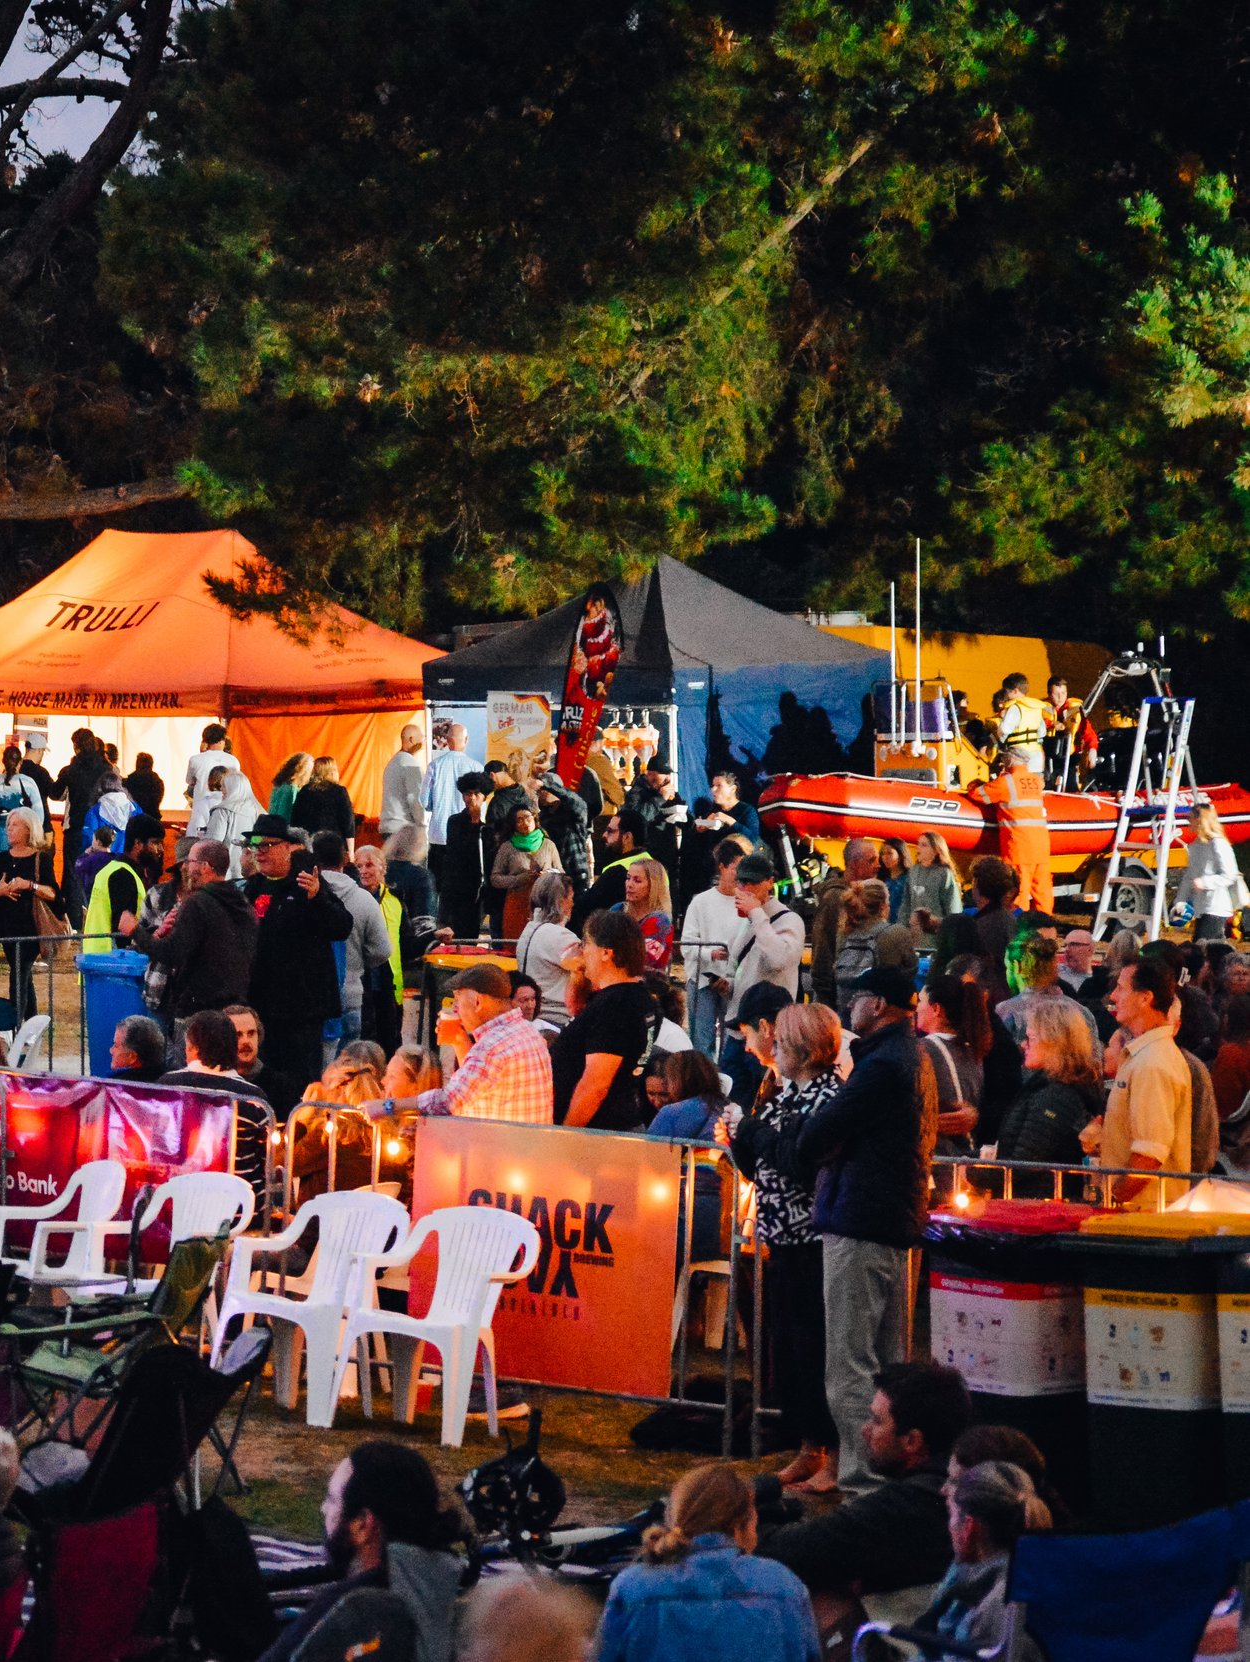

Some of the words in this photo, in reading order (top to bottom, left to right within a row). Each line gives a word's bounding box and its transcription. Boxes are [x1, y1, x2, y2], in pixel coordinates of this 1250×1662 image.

[46, 601, 160, 632] TRULLI
[8, 690, 90, 710] HOUSE-MADE
[92, 693, 107, 709] IN
[492, 702, 533, 713] GERMAN
[1019, 777, 1039, 790] SES
[17, 1171, 58, 1197] Bank
